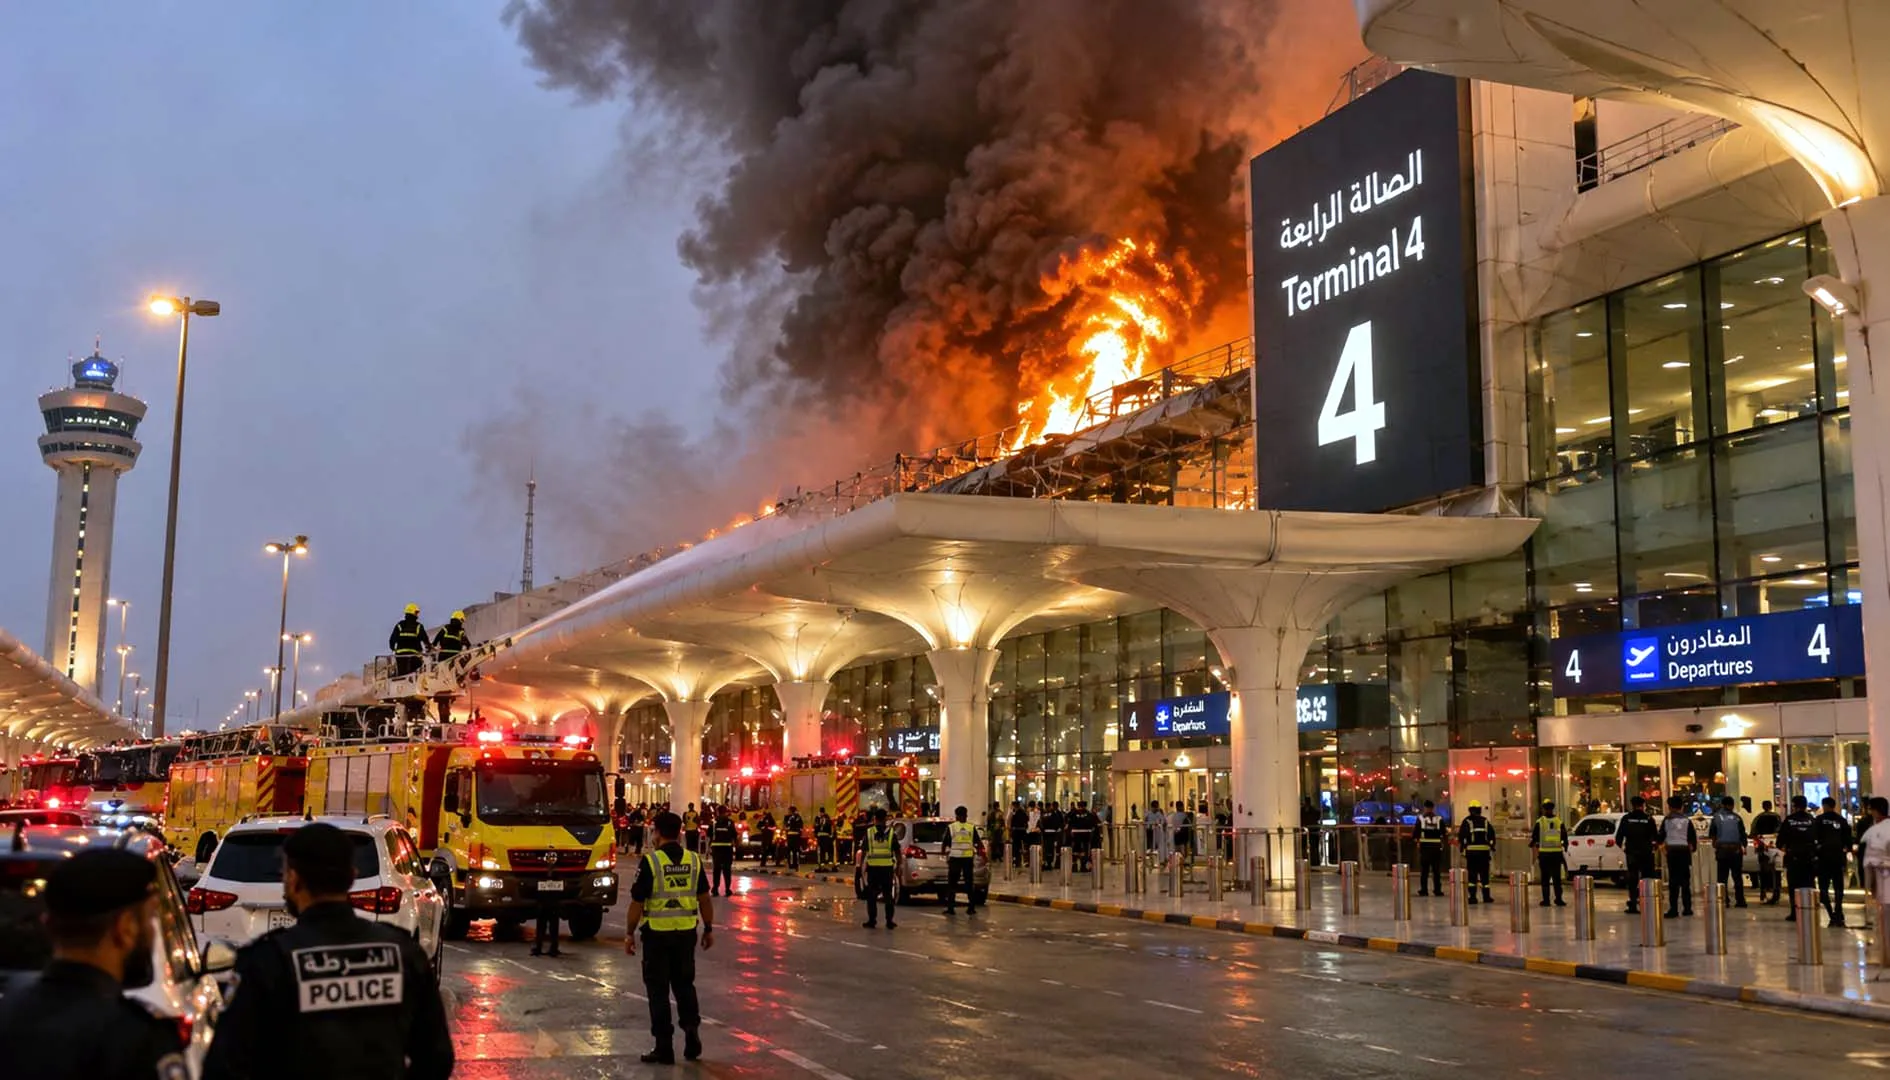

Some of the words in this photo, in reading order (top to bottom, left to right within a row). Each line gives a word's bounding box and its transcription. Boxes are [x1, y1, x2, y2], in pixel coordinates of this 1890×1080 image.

[1350, 148, 1423, 213] الصالة
[1280, 189, 1342, 248] الرابعة
[1281, 227, 1400, 317] Terminal
[1405, 215, 1425, 262] 4
[1317, 319, 1386, 466] 4
[1667, 625, 1751, 656] المغادرون
[1806, 623, 1831, 664] 4
[1565, 649, 1582, 683] 4
[1668, 660, 1753, 682] Departures
[1129, 711, 1138, 731] 4
[303, 948, 395, 976] الشرطة
[309, 978, 395, 1005] POLICE
